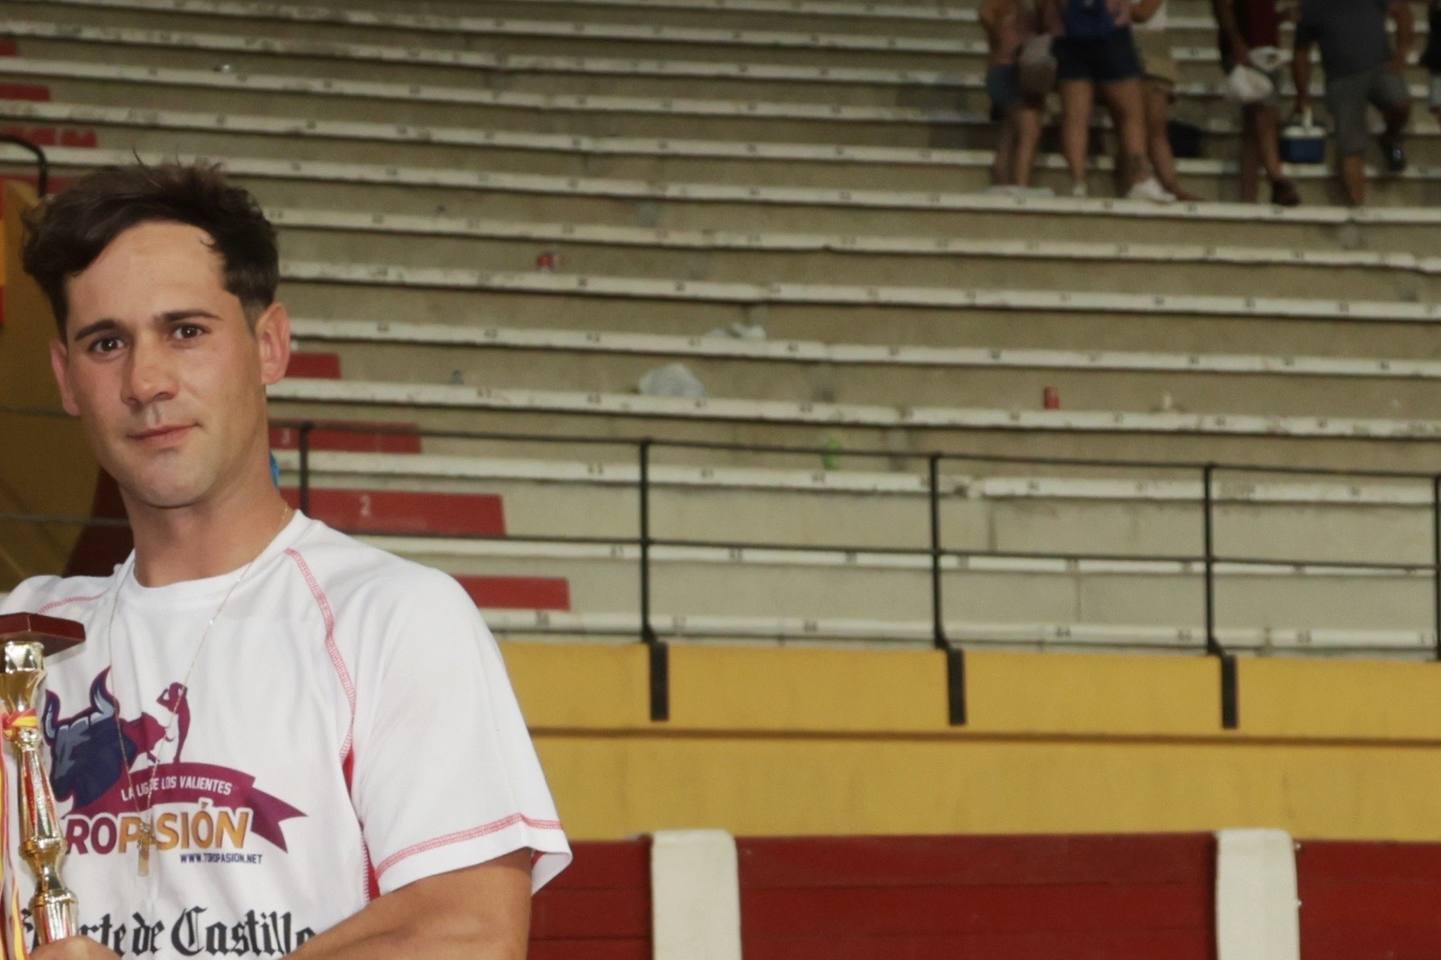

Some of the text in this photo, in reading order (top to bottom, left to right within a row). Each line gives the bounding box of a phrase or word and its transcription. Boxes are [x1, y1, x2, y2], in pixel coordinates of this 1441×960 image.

[360, 495, 372, 517] 2
[121, 786, 134, 801] LA
[161, 776, 177, 790] LOS
[180, 776, 233, 796] VALIENTES
[133, 912, 165, 955] de
